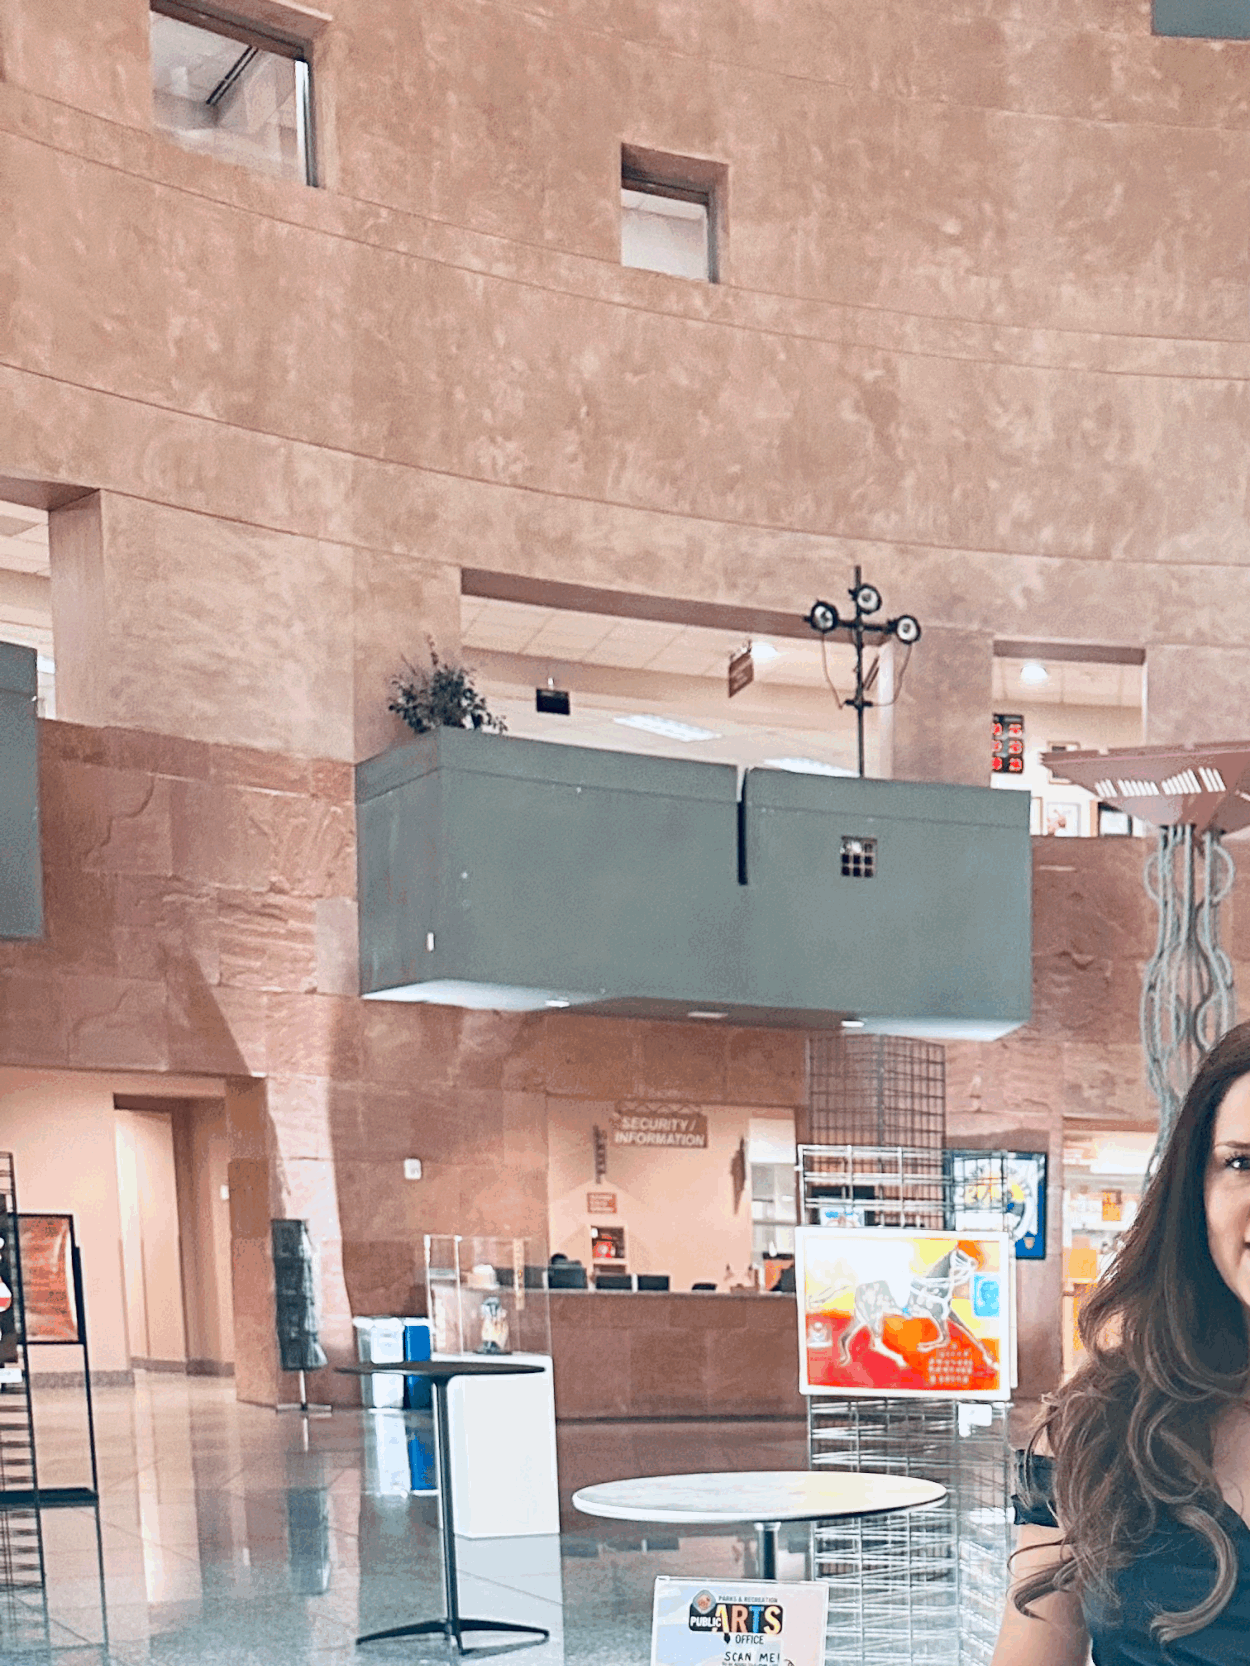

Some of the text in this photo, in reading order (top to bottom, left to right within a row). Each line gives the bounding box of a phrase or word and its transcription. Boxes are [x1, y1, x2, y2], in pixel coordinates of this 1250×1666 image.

[615, 1131, 705, 1146] INFORMATION
[689, 1604, 782, 1635] PUBLIC ARTS
[735, 1634, 765, 1645] OFFICE
[724, 1651, 780, 1663] SCAN ME!
